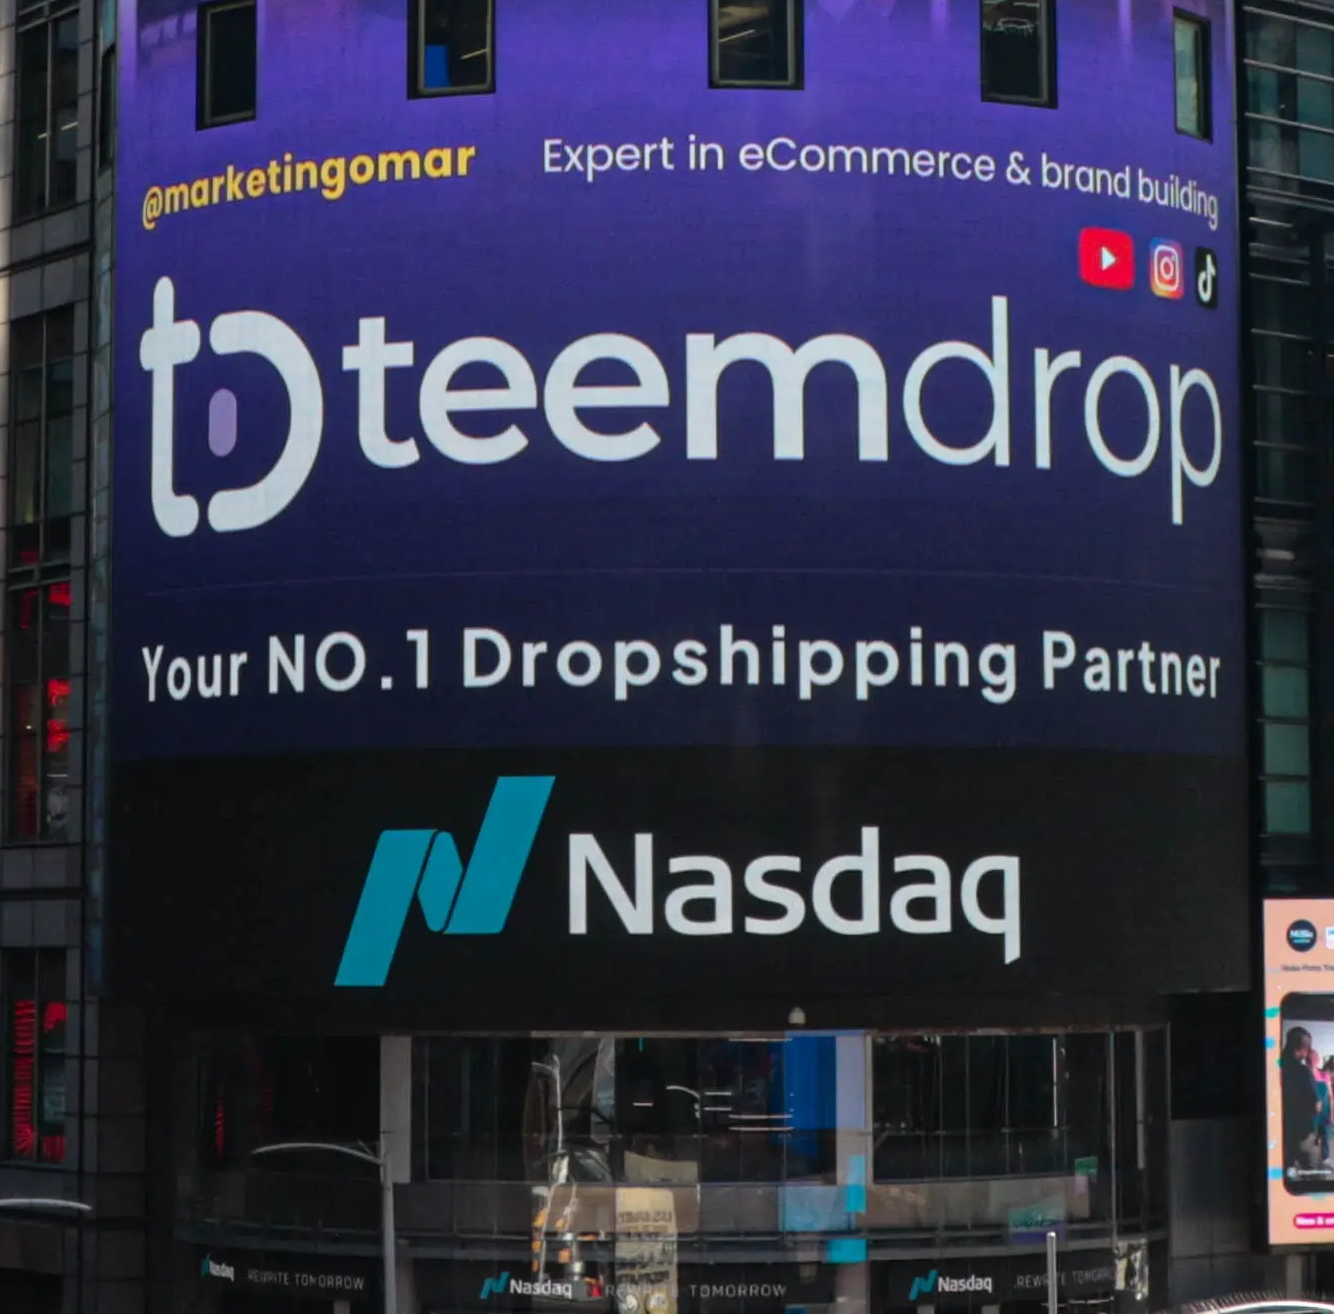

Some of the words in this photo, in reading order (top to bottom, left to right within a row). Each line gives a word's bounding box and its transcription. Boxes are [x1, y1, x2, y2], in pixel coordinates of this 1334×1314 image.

[141, 140, 475, 230] @marketingomar
[543, 137, 674, 185] Expert
[688, 134, 724, 173] in
[739, 137, 996, 183] eCommerce
[1007, 150, 1031, 187] &
[1041, 155, 1131, 201] brand
[1137, 166, 1219, 231] building
[342, 295, 1222, 525] teemdrop
[142, 646, 248, 703] Your
[465, 624, 1016, 704] Dropshipping
[1043, 630, 1221, 699] Partner
[568, 825, 1020, 966] Nasdaq
[295, 1272, 365, 1291] TOMORROW
[510, 1278, 573, 1299] Nasdaq
[689, 1283, 787, 1299] TOMORROW
[938, 1273, 994, 1294] Nasdaq
